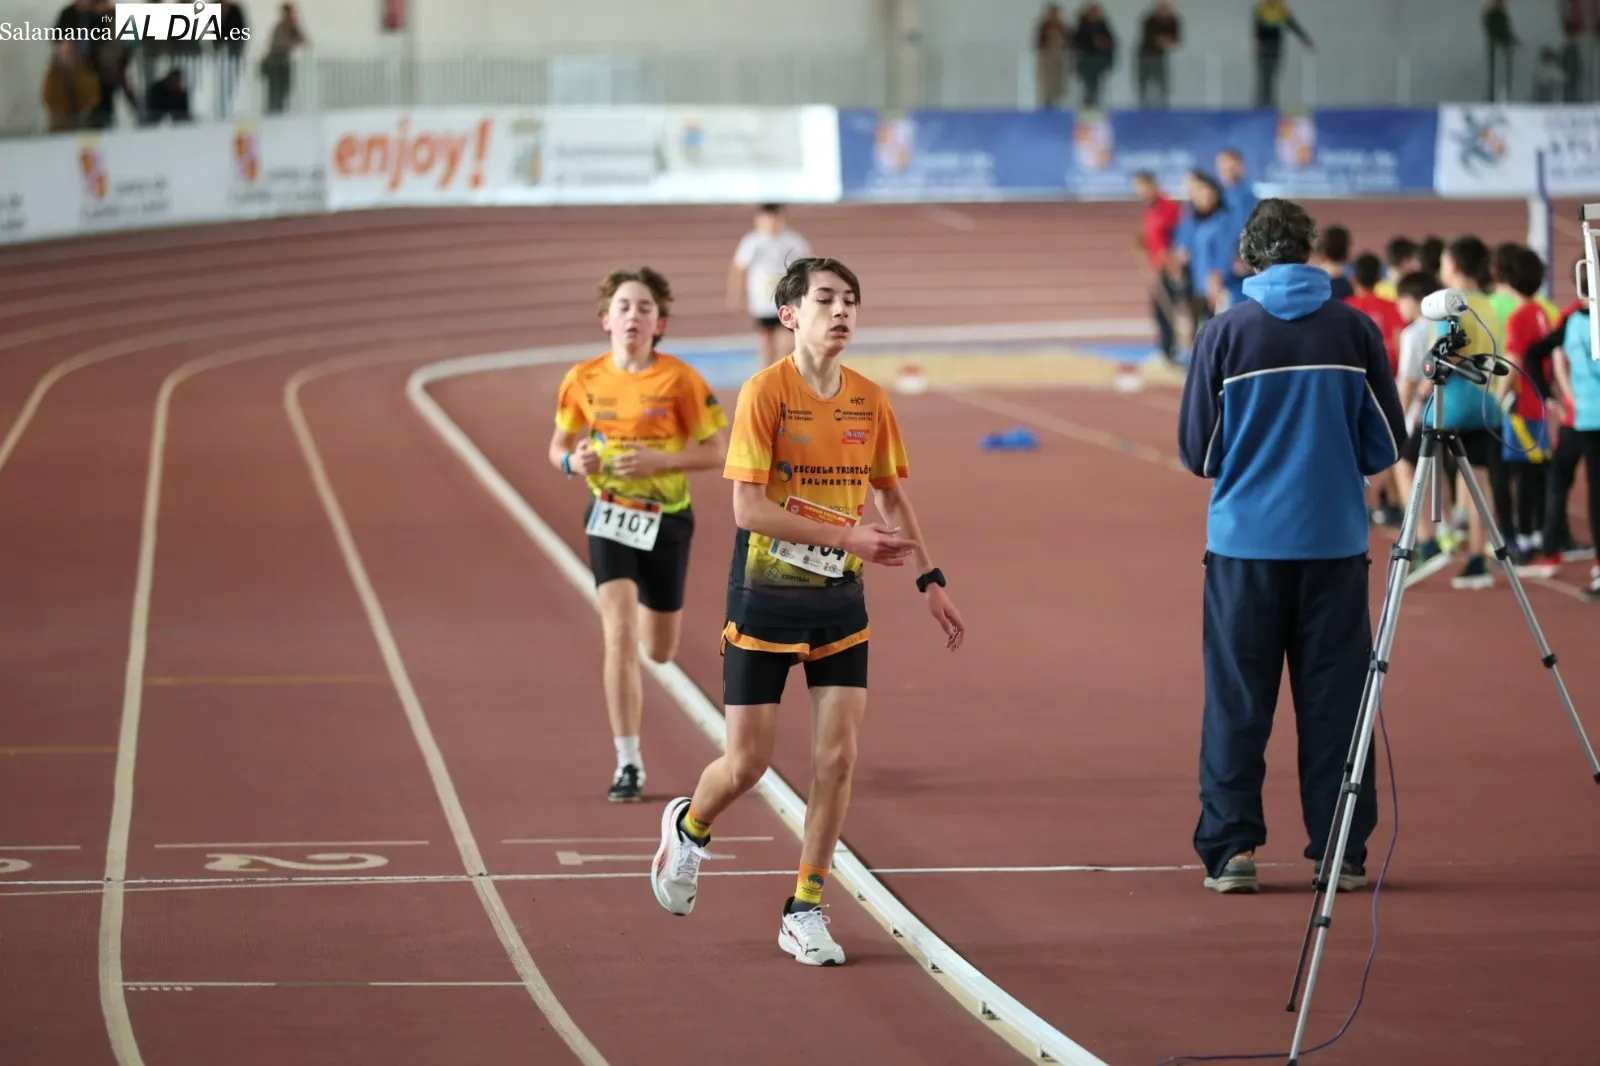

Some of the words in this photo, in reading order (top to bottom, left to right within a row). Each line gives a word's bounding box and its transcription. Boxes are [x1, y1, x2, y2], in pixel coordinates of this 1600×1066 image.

[332, 116, 493, 192] enjoy!
[794, 465, 834, 475] ESCUELA
[801, 477, 862, 486] SALMANTINA
[602, 507, 654, 536] 1107
